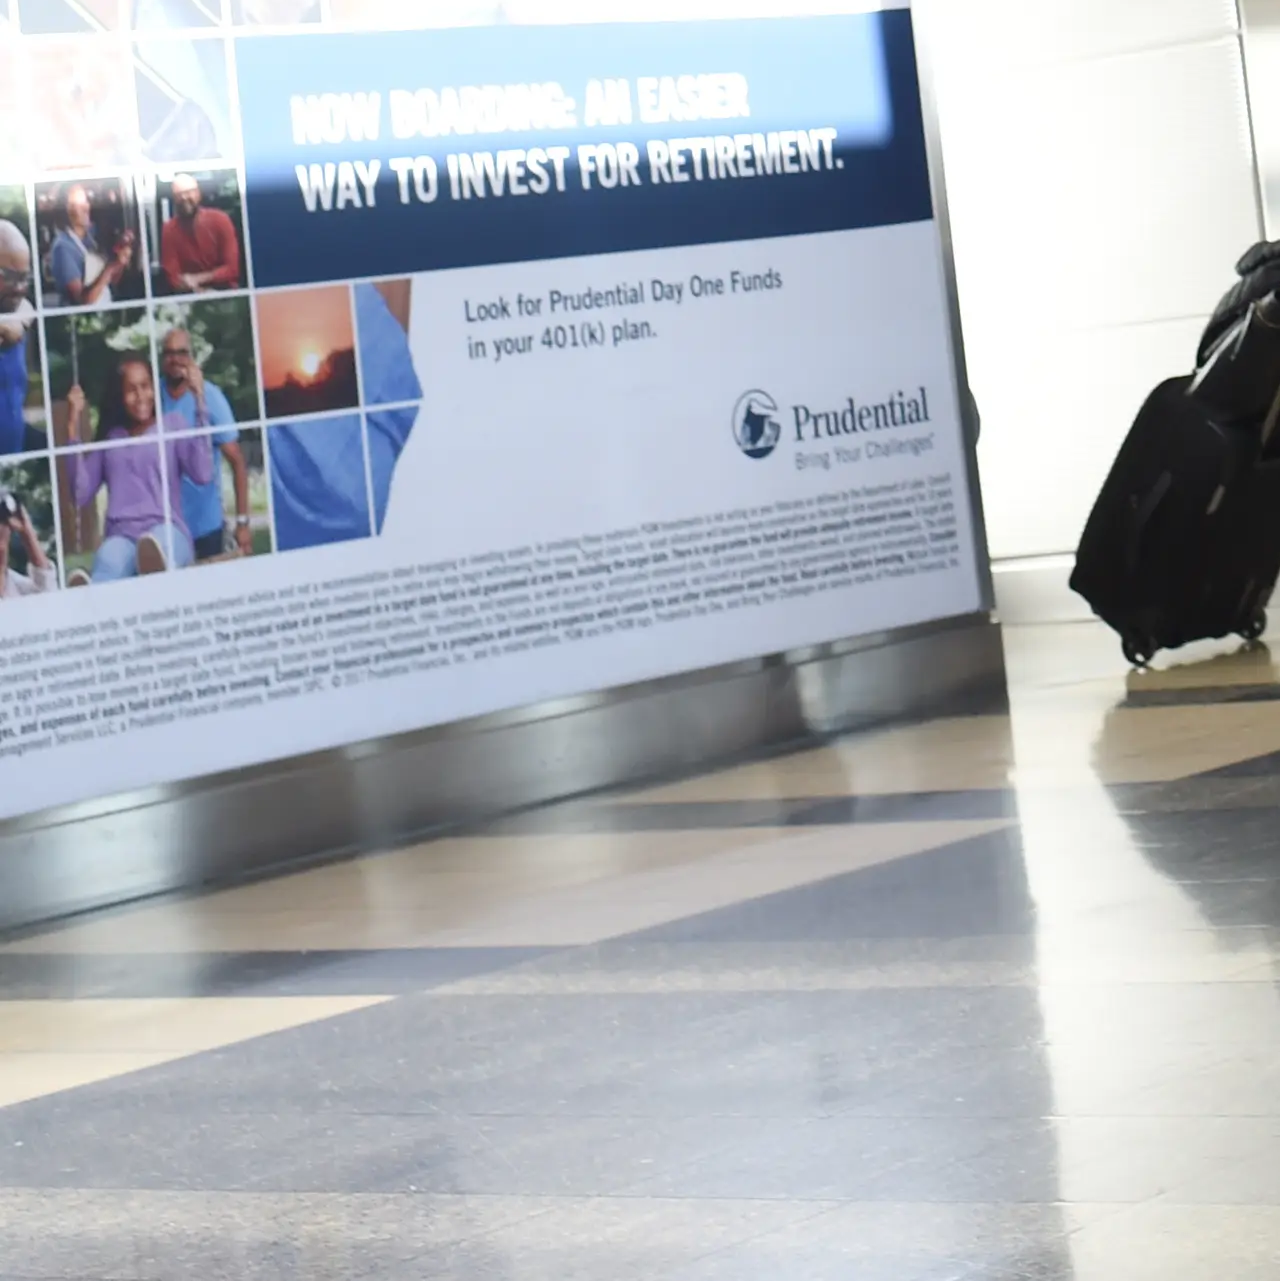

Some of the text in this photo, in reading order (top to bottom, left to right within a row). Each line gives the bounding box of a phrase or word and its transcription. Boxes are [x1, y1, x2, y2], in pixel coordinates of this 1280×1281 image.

[290, 91, 381, 144] NOW
[584, 78, 632, 126] AN
[637, 72, 750, 124] EASIER
[295, 127, 845, 212] WAY TO INVEST FOR RETIREMENT.
[464, 268, 783, 323] Look for Prudential Day One Funds
[467, 319, 658, 362] in your 401(k) plan.
[792, 386, 933, 442] Prudential
[795, 451, 831, 471] Bring
[835, 446, 861, 464] Your
